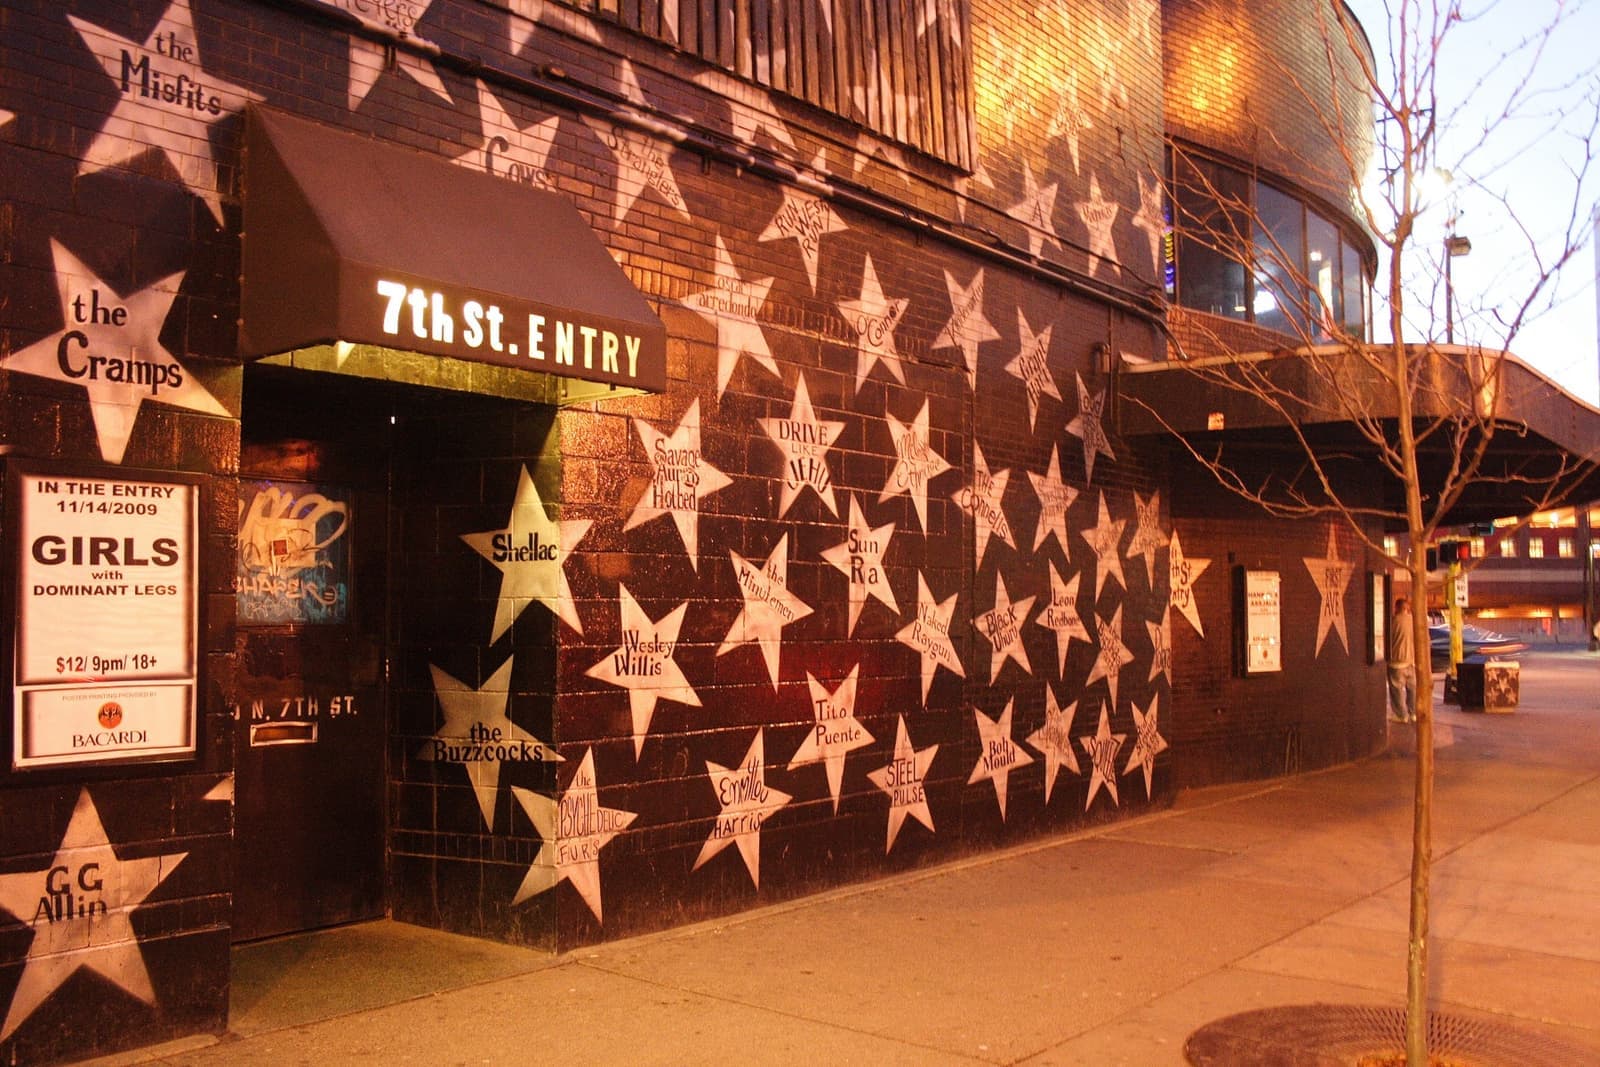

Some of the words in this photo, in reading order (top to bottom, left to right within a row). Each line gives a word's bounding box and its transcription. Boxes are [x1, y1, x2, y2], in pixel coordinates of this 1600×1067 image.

[154, 31, 194, 64] the
[119, 48, 223, 117] Misfits
[774, 198, 799, 237] RUN
[802, 215, 824, 260] RUN
[71, 289, 128, 327] the
[376, 279, 454, 344] 7th
[462, 300, 519, 356] St.
[528, 313, 641, 378] ENTRY
[56, 330, 184, 396] Cramps
[779, 420, 828, 446] DRIVE
[654, 437, 701, 469] Savage
[791, 442, 817, 457] LIKE
[37, 481, 59, 494] IN
[66, 482, 105, 496] THE
[112, 484, 175, 498] ENTRY
[652, 480, 697, 511] Hotbed
[57, 501, 158, 516] 11/14/2009
[961, 486, 1008, 540] Connells
[31, 535, 180, 567] GIRLS
[490, 532, 558, 563] Shellac
[848, 528, 879, 554] Sun
[91, 570, 123, 580] with
[766, 562, 785, 585] the
[850, 555, 879, 585] Ra
[33, 584, 129, 596] DOMINANT
[134, 584, 178, 596] LEGS
[738, 565, 794, 622] Minutemen
[1053, 588, 1075, 607] Leon
[918, 601, 949, 637] Naked
[985, 606, 1018, 637] Black
[623, 630, 674, 659] Wesley
[911, 621, 952, 663] Raygun
[56, 656, 88, 674] $12/
[92, 655, 128, 675] 9pm/
[132, 653, 158, 671] 18+
[614, 653, 662, 677] Willis
[280, 696, 319, 718] 7TH
[329, 695, 358, 719] ST.
[815, 699, 847, 721] Tito
[72, 730, 148, 749] BACARDI
[470, 721, 502, 744] the
[815, 724, 861, 747] Puente
[989, 736, 1009, 758] Bob
[433, 738, 543, 762] Buzzcocks
[983, 744, 1016, 775] Mould
[575, 773, 592, 787] the
[886, 757, 922, 788] STEEL
[893, 785, 924, 808] PULSE
[559, 792, 625, 838] PSYCHEDELIC
[559, 839, 601, 865] FURS
[32, 895, 108, 925] Allin
